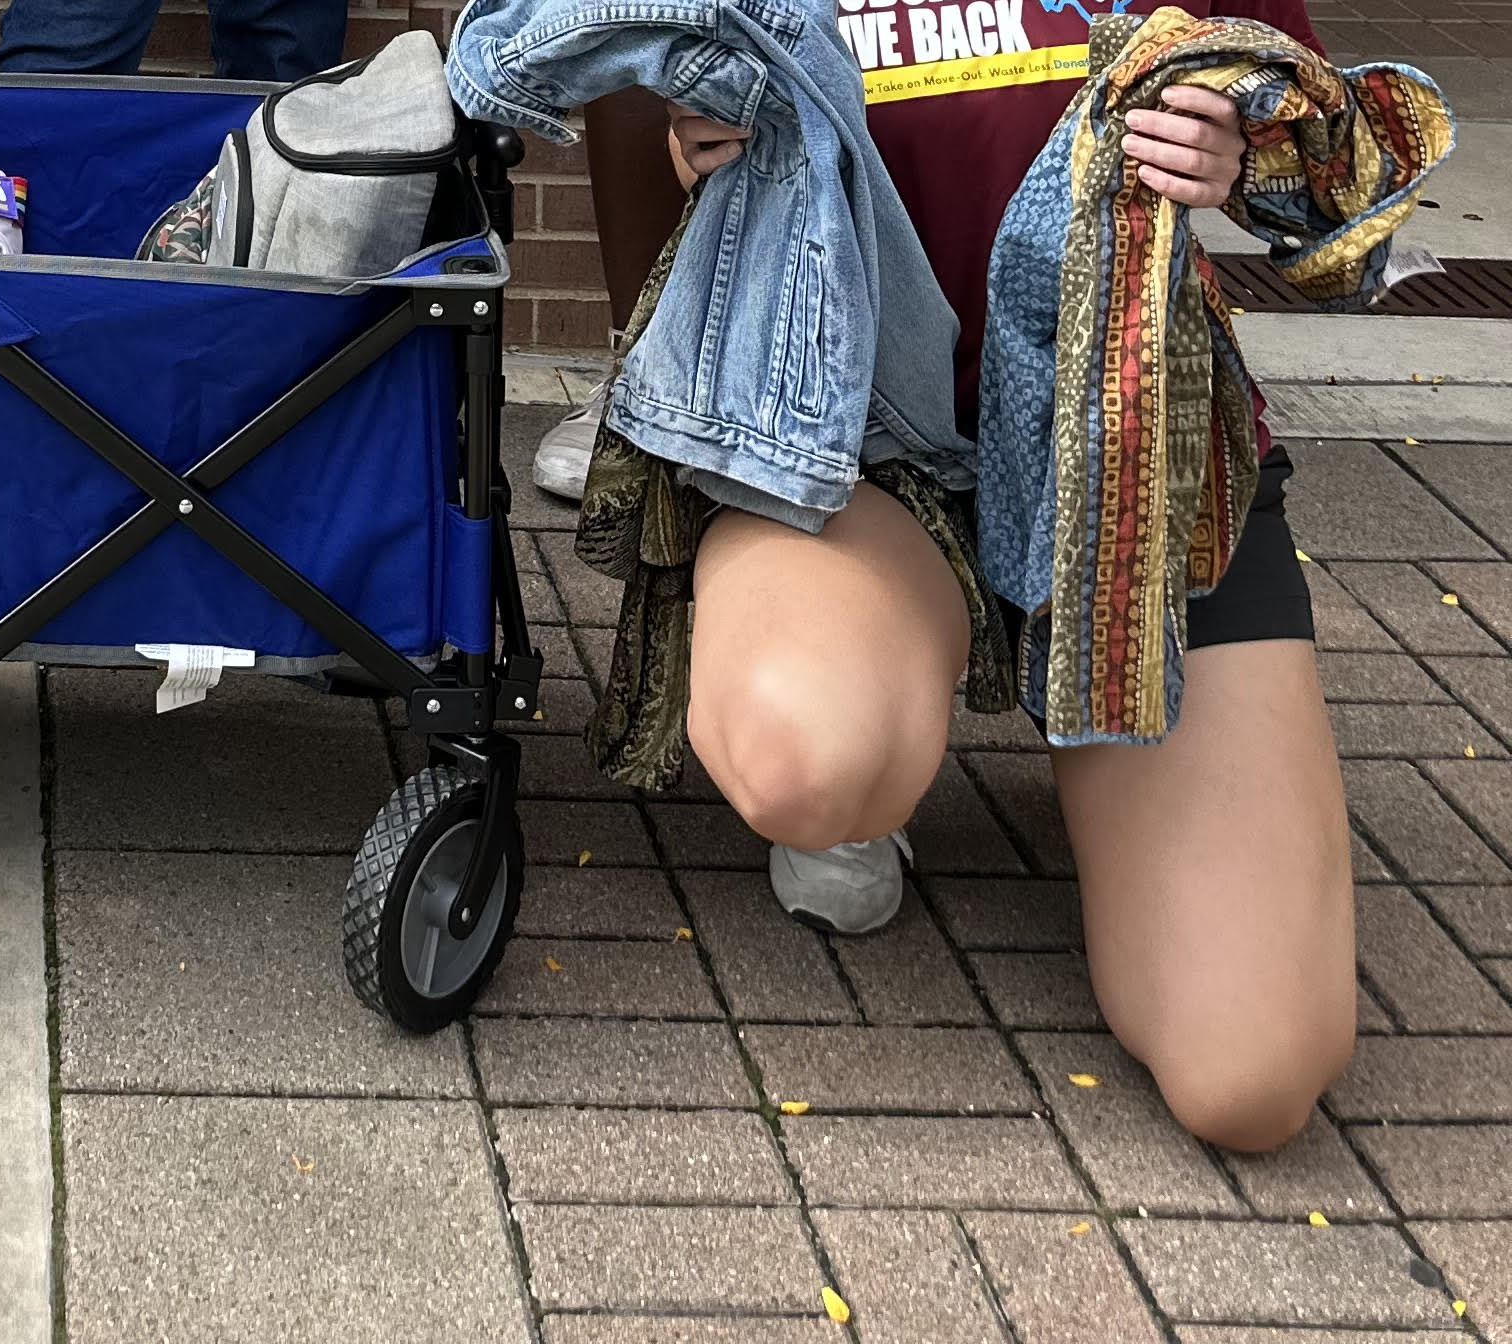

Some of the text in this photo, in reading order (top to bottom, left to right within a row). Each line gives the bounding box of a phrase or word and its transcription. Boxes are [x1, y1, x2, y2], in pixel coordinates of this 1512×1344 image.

[838, 11, 903, 70] IVE
[876, 81, 903, 93] Take
[907, 80, 920, 89] on
[988, 65, 1025, 77] Waste
[1054, 57, 1089, 69] Donat
